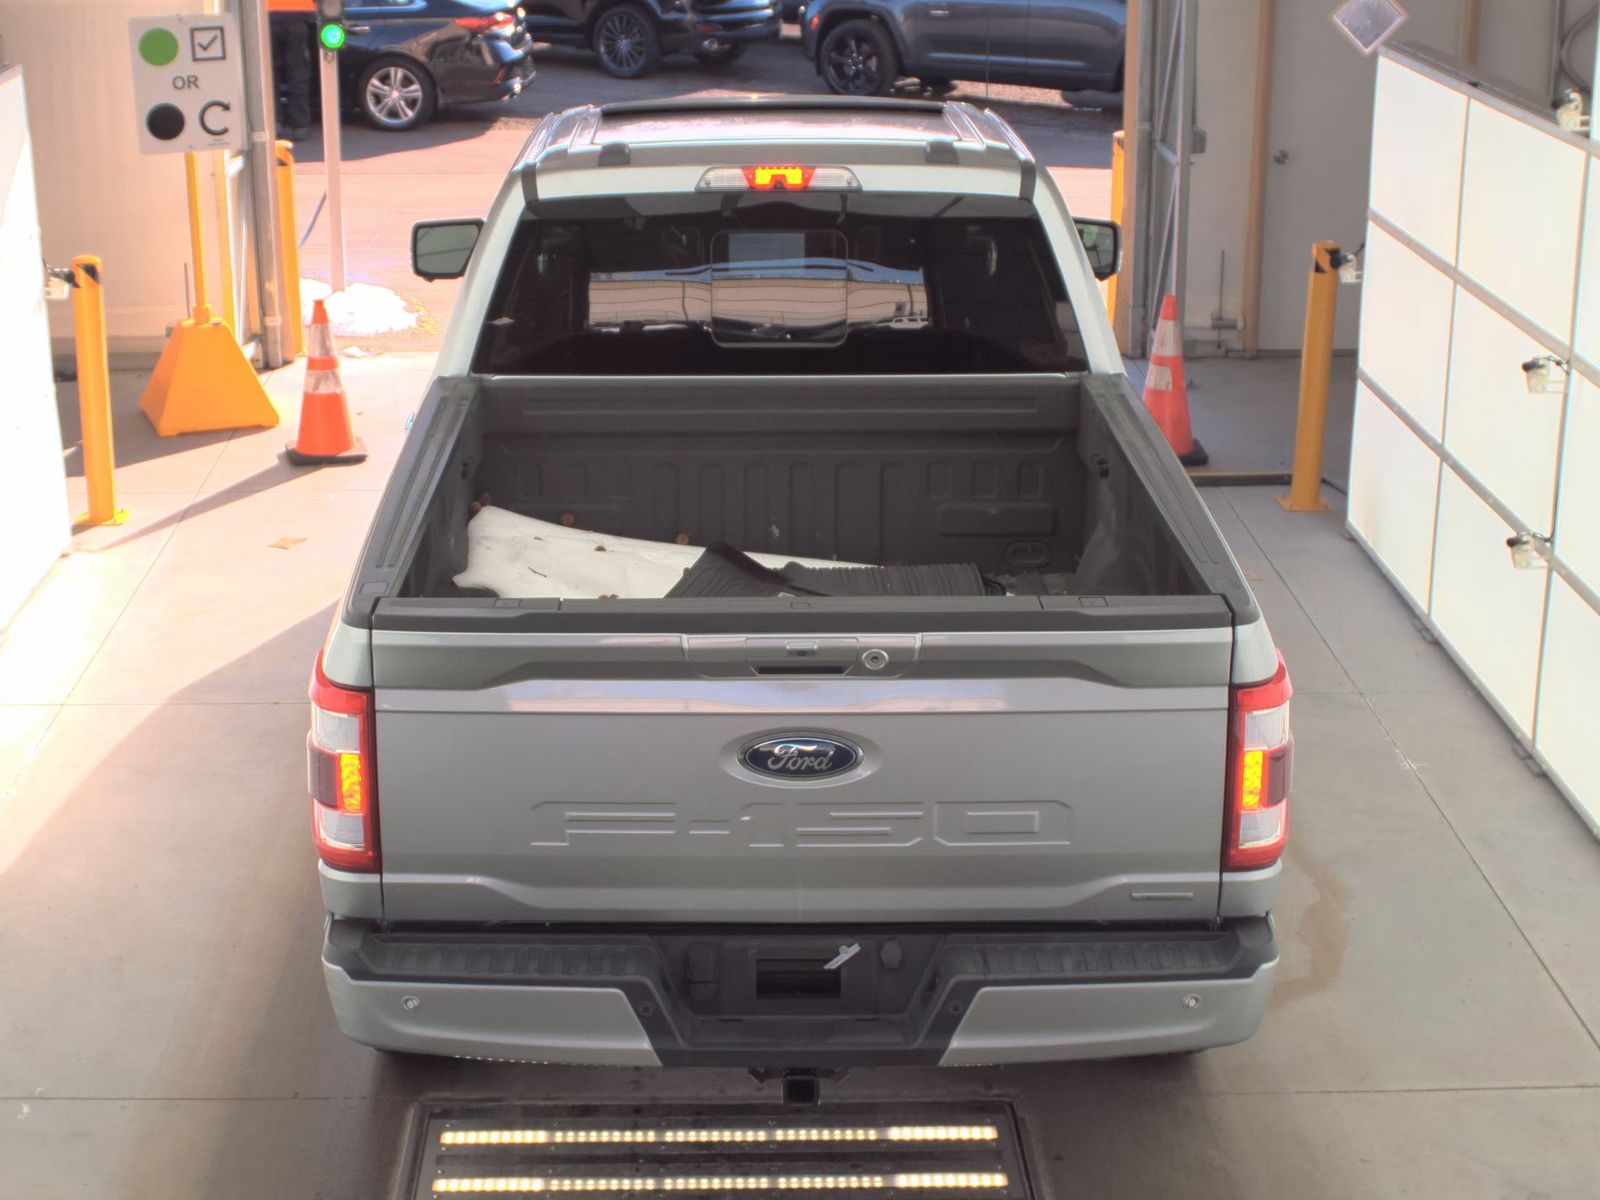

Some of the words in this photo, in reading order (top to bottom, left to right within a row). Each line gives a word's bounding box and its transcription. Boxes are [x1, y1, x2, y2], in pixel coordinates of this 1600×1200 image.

[172, 74, 200, 90] OR
[767, 743, 834, 770] Ford
[530, 800, 1073, 847] F-150
